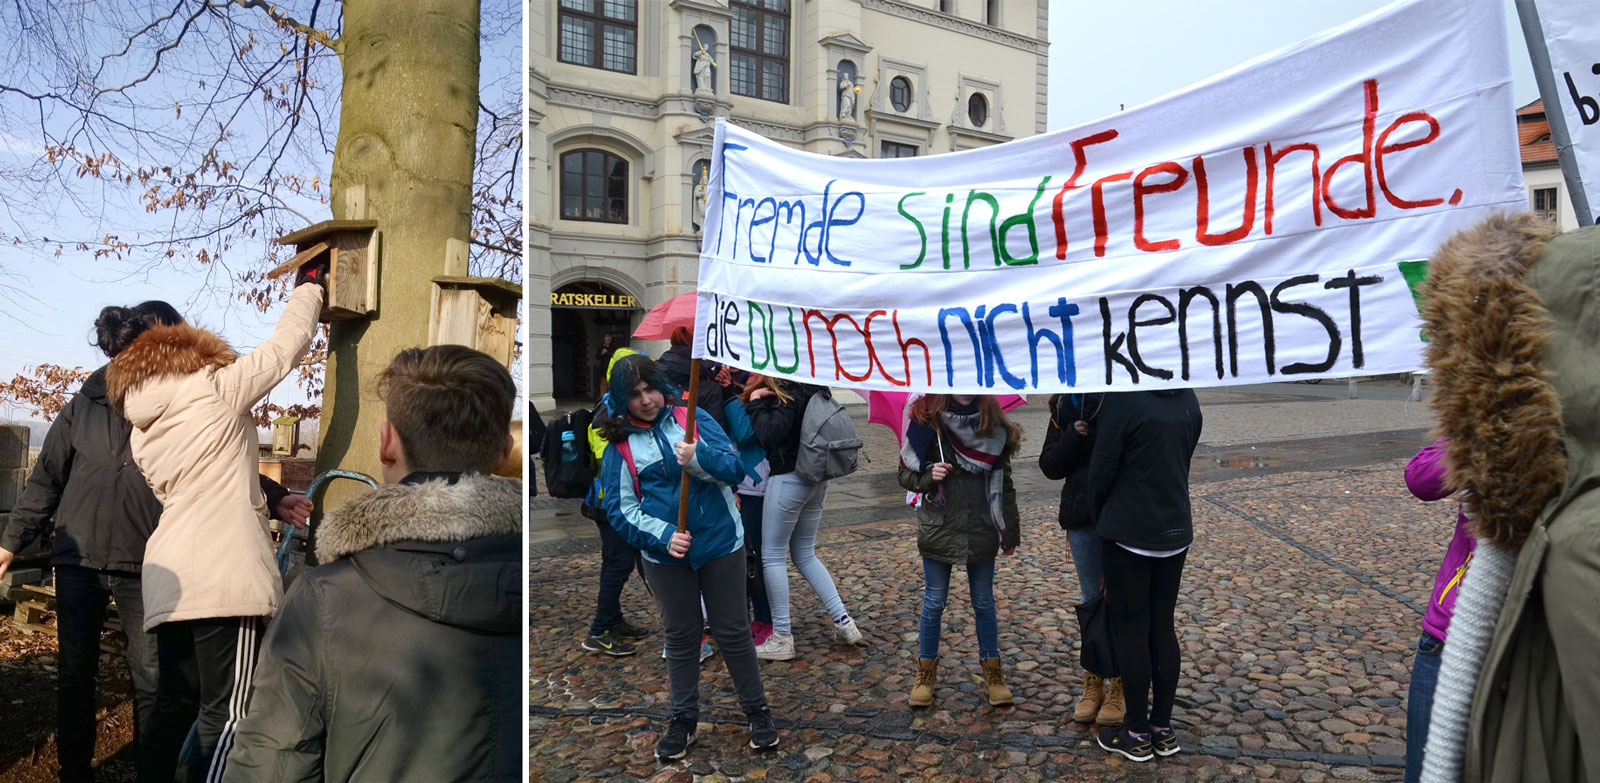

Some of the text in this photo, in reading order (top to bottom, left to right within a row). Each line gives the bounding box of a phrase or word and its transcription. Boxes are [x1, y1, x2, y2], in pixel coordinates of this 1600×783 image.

[716, 142, 866, 267] Fremde
[1051, 78, 1463, 261] Freunde.
[550, 292, 637, 308] RATSKELLER
[705, 293, 741, 361] die
[800, 307, 932, 387] noch
[937, 297, 1080, 389] nicht
[1099, 269, 1385, 386] kennst
